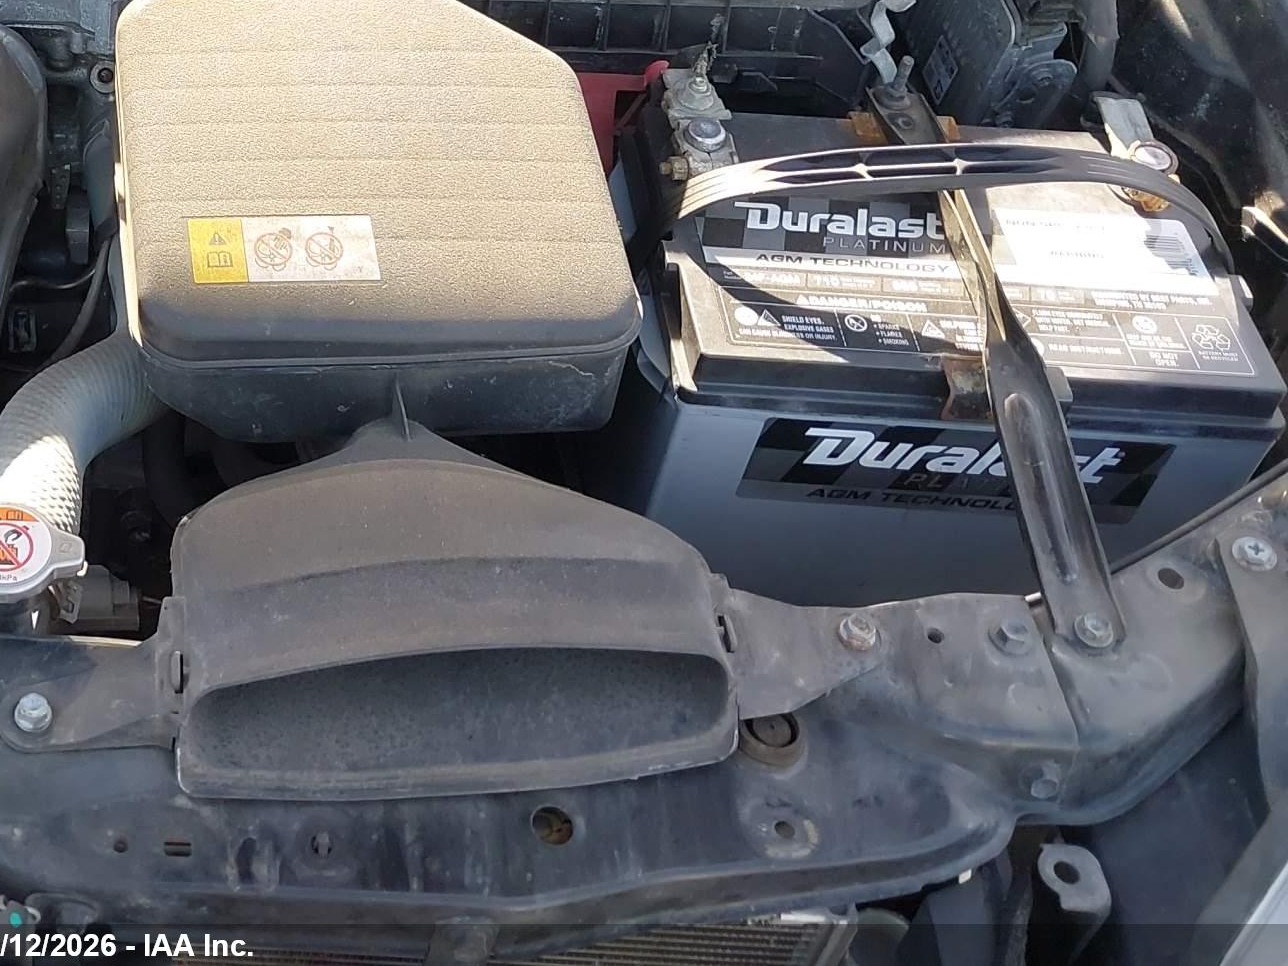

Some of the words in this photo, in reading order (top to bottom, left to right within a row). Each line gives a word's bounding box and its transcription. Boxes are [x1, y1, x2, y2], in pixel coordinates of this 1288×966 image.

[734, 201, 946, 240] Duralast
[822, 236, 947, 254] PLATINUM
[755, 253, 804, 264] AGM
[810, 257, 951, 274] TECHNOLOGY
[802, 427, 1121, 484] Duralt
[805, 487, 871, 501] AGM
[880, 491, 1016, 511] TECHNOL
